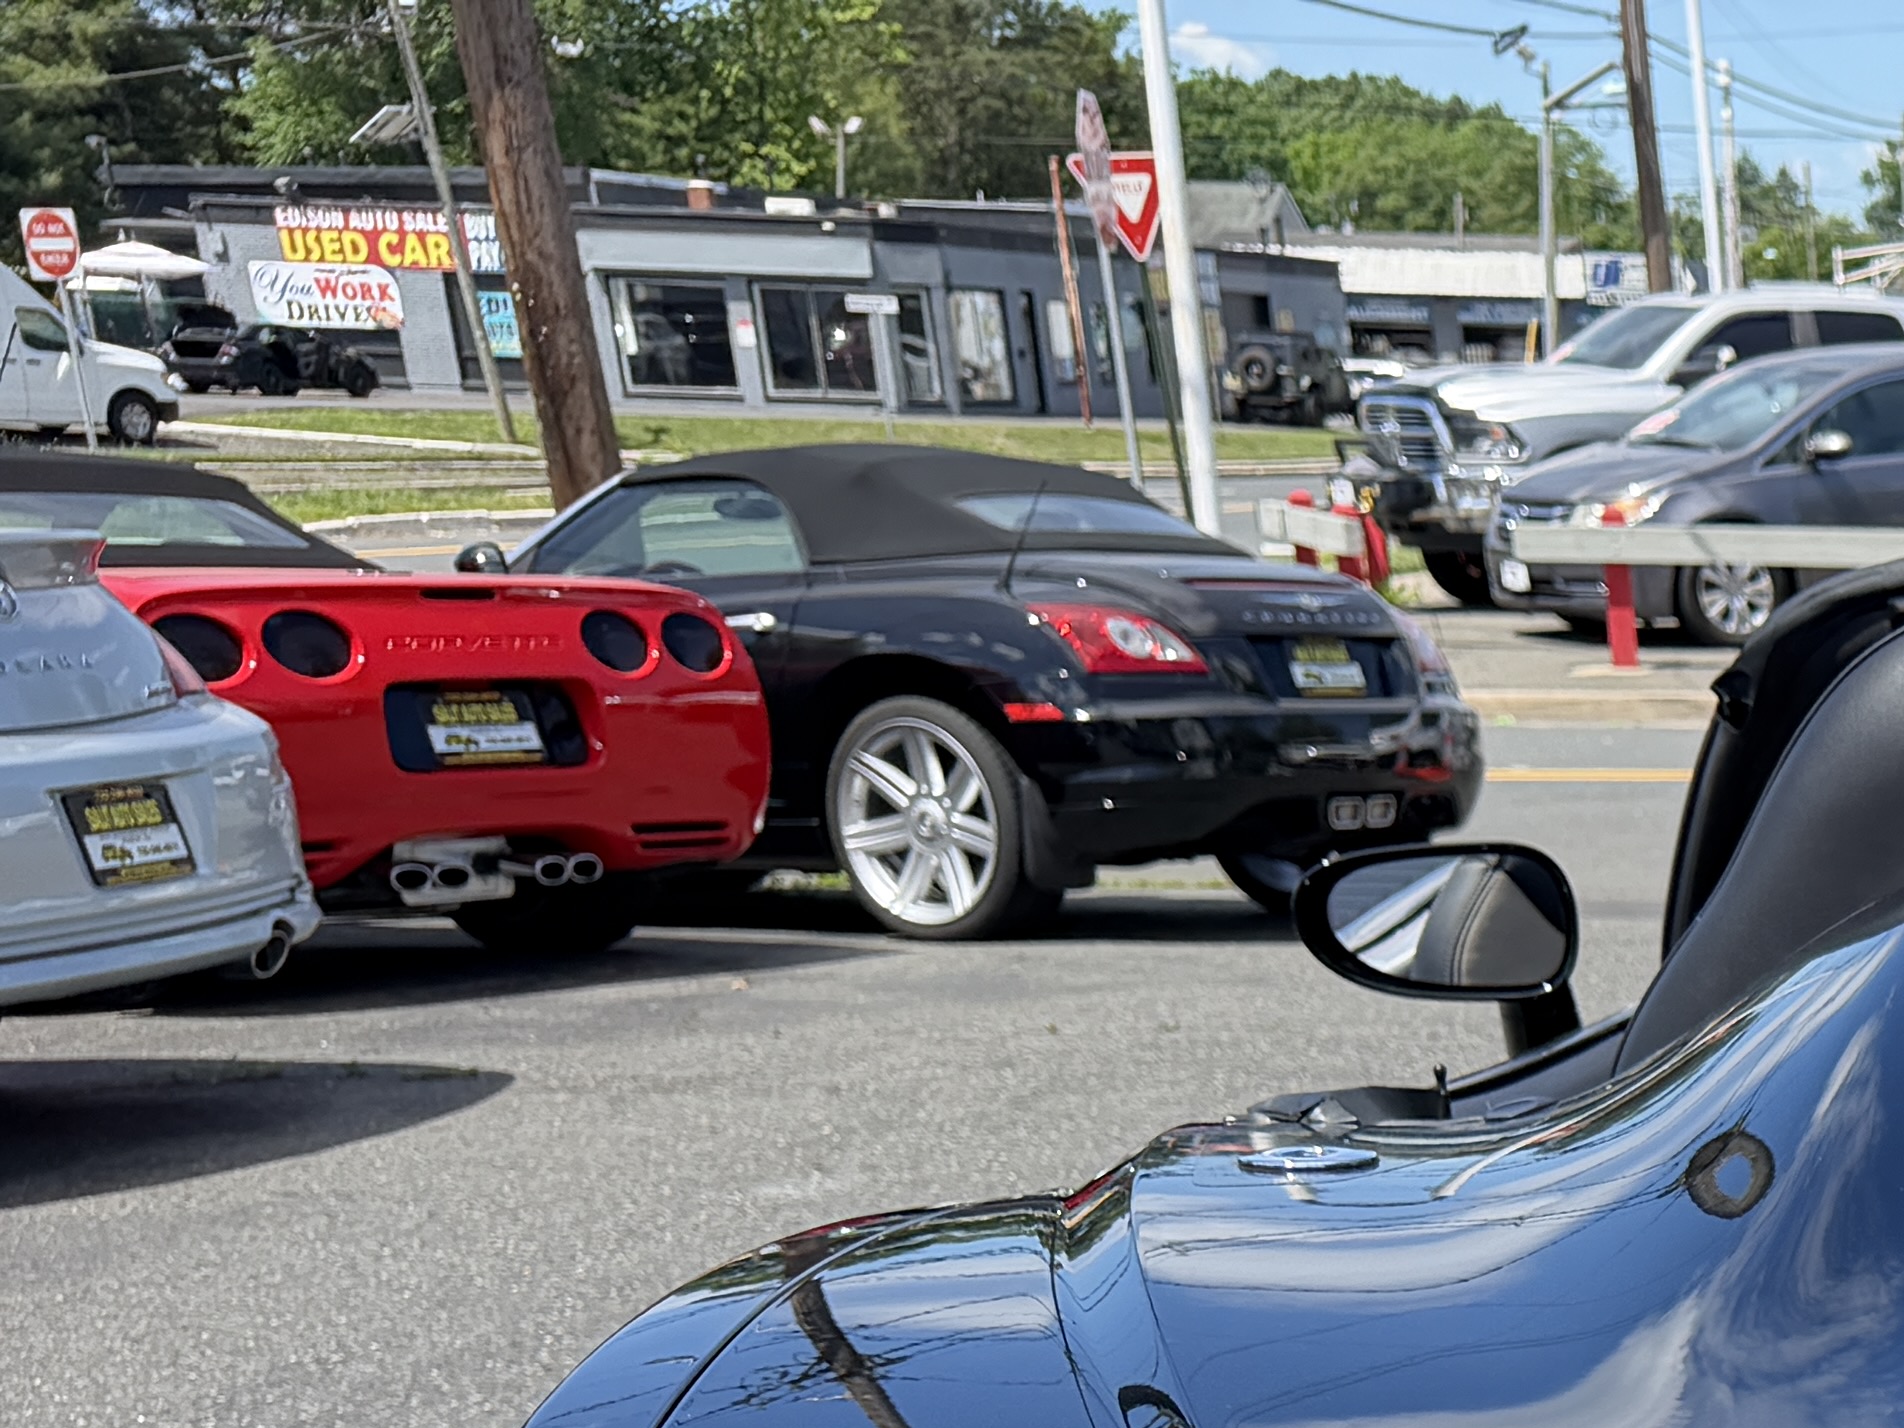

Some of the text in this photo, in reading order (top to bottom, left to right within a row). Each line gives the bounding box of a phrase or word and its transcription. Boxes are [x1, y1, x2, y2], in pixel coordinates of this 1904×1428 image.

[348, 210, 399, 232] AUTO
[278, 228, 369, 263] USED
[253, 262, 396, 304] You WORK
